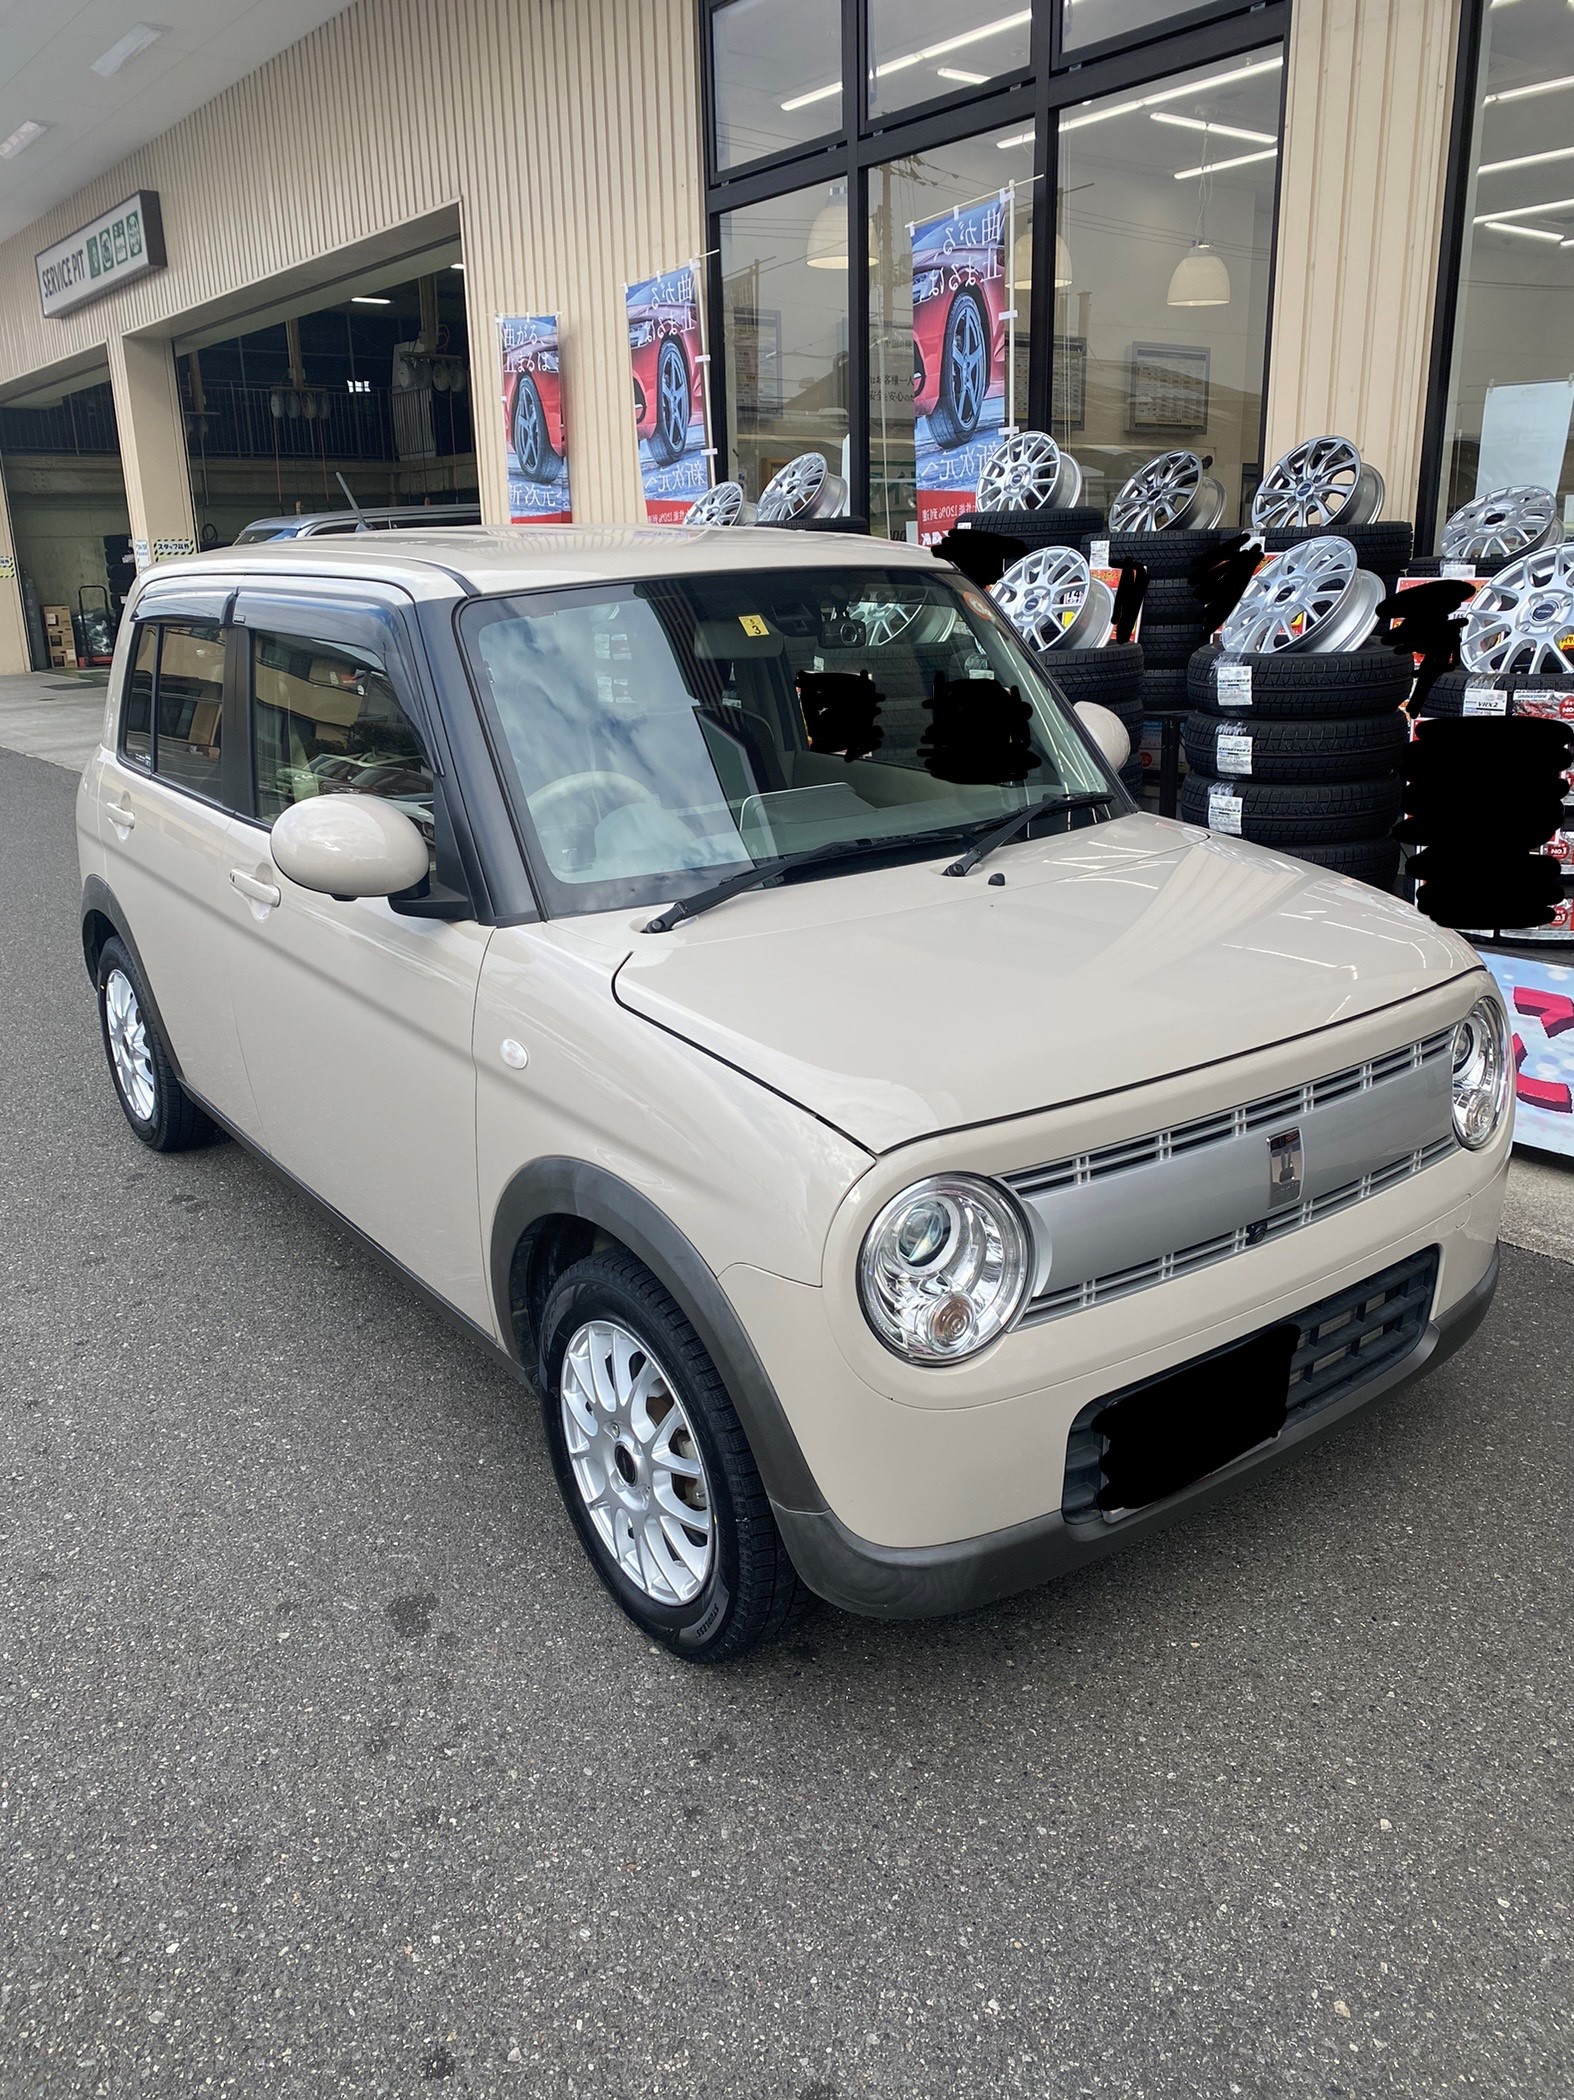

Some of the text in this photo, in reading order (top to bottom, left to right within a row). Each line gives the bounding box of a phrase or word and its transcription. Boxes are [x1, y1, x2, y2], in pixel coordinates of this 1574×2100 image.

[42, 249, 85, 298] SERVICE PIT
[751, 625, 762, 635] 3
